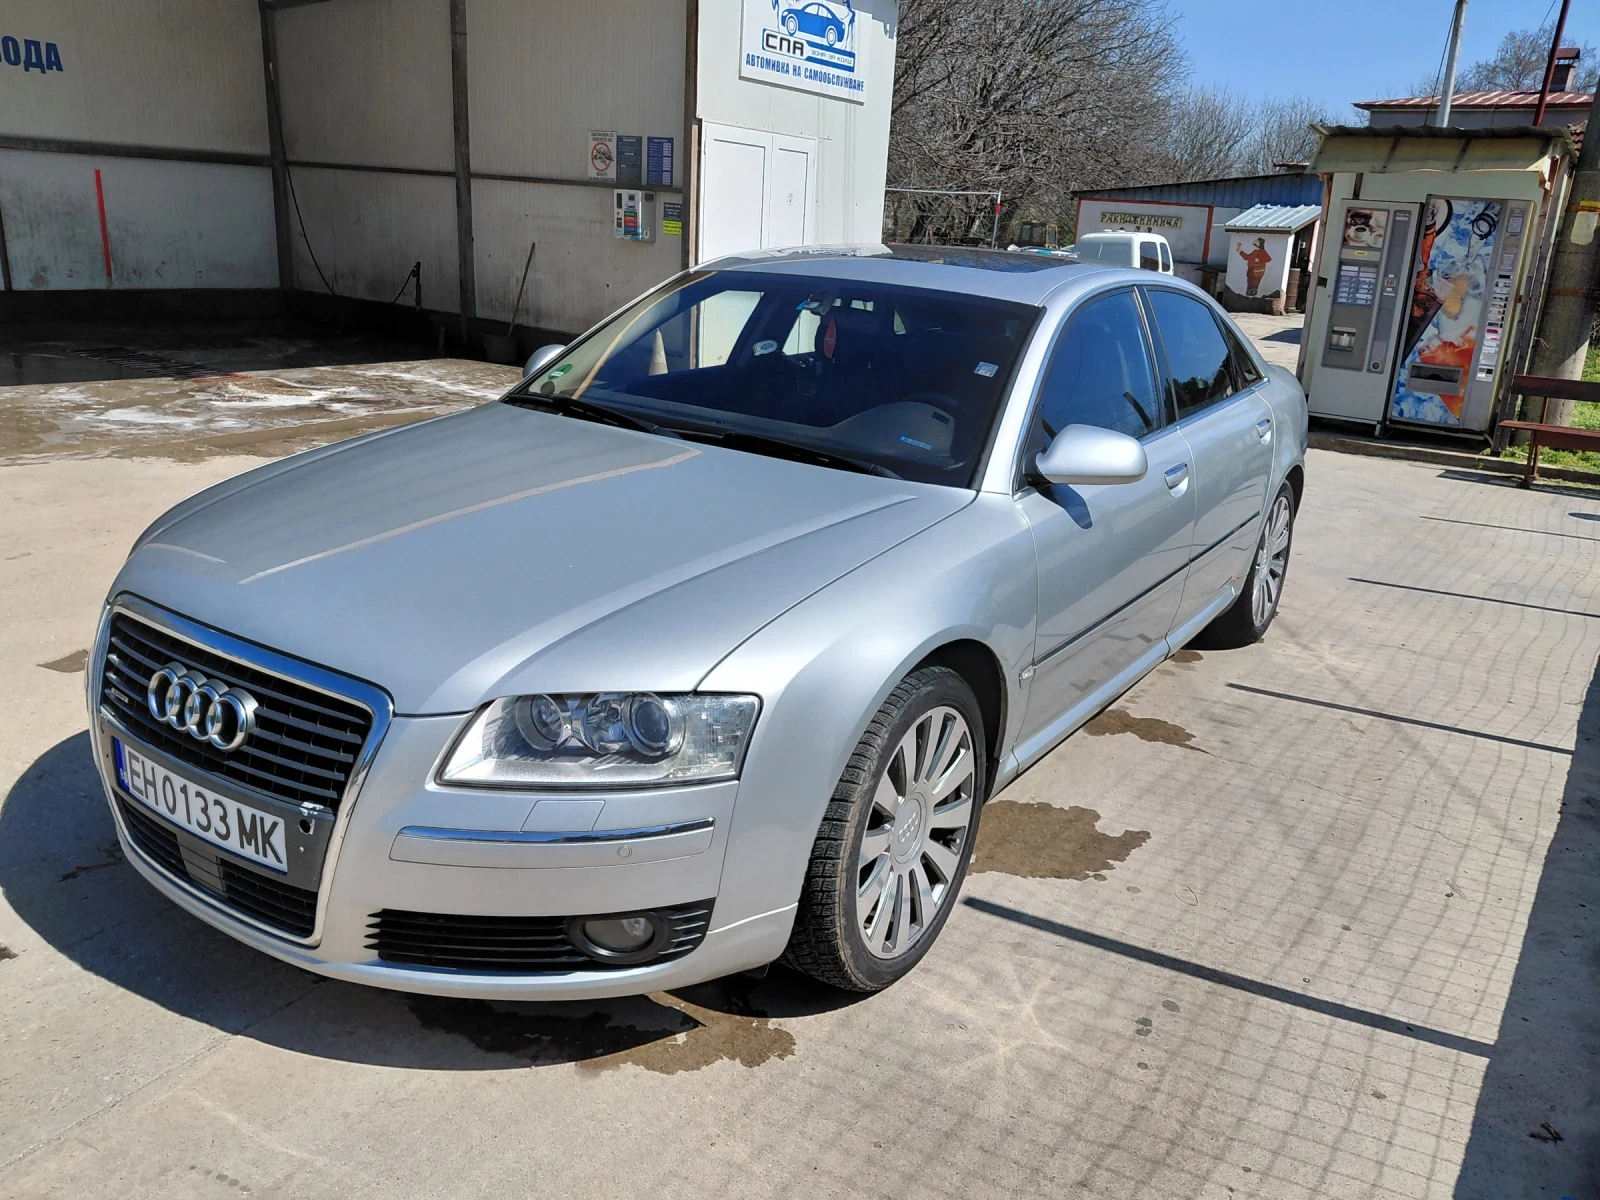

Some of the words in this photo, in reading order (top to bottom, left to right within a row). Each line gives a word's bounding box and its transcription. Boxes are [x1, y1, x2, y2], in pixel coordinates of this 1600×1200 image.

[0, 35, 64, 74] ОДА
[765, 33, 804, 57] СПА
[746, 53, 790, 76] АВТОМИВКА
[792, 65, 802, 78] НА
[804, 67, 865, 92] САМООБСЛУЖВАНЕ
